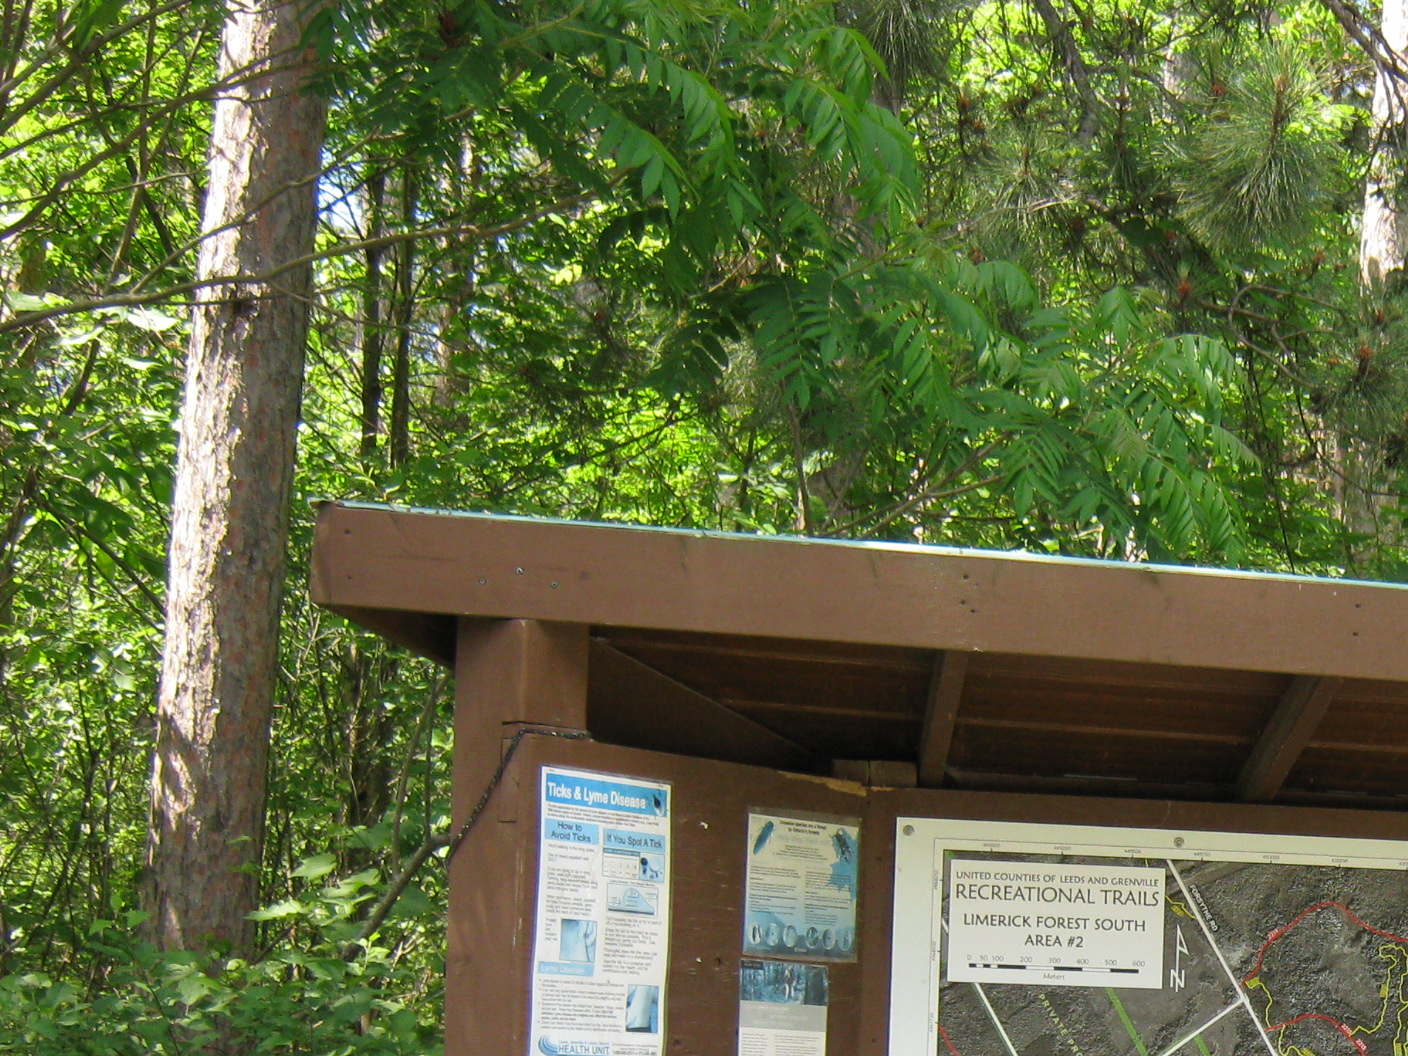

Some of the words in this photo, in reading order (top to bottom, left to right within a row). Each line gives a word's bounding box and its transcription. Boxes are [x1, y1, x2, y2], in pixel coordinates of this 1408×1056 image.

[548, 782, 572, 798] Ticks
[574, 786, 582, 800] &
[584, 787, 608, 805] Lyme
[610, 791, 646, 809] Disease
[558, 822, 573, 830] How
[551, 830, 570, 840] Avoid
[573, 832, 591, 842] Ticks
[613, 835, 626, 845] You
[628, 836, 642, 848] Spot
[650, 839, 662, 848] Tick
[956, 871, 992, 880] UNITED
[994, 872, 1040, 882] COUNTIES
[1043, 874, 1056, 882] OF
[1060, 875, 1085, 884] LEEDS
[1088, 876, 1108, 885] AND
[1111, 878, 1159, 887] GRENVILLE
[956, 884, 1095, 904] RECREATIONAL
[1101, 890, 1159, 906] TRAILS
[963, 913, 1031, 928] LIMERICK
[1036, 916, 1090, 930] FOREST
[1094, 918, 1146, 932] SOUTH
[1025, 935, 1062, 947] AREA
[1068, 936, 1084, 948] #2
[1043, 973, 1065, 981] Meters
[1039, 994, 1069, 1036] PRIVATE
[558, 1045, 590, 1054] HEALTH
[591, 1046, 610, 1055] UNIT
